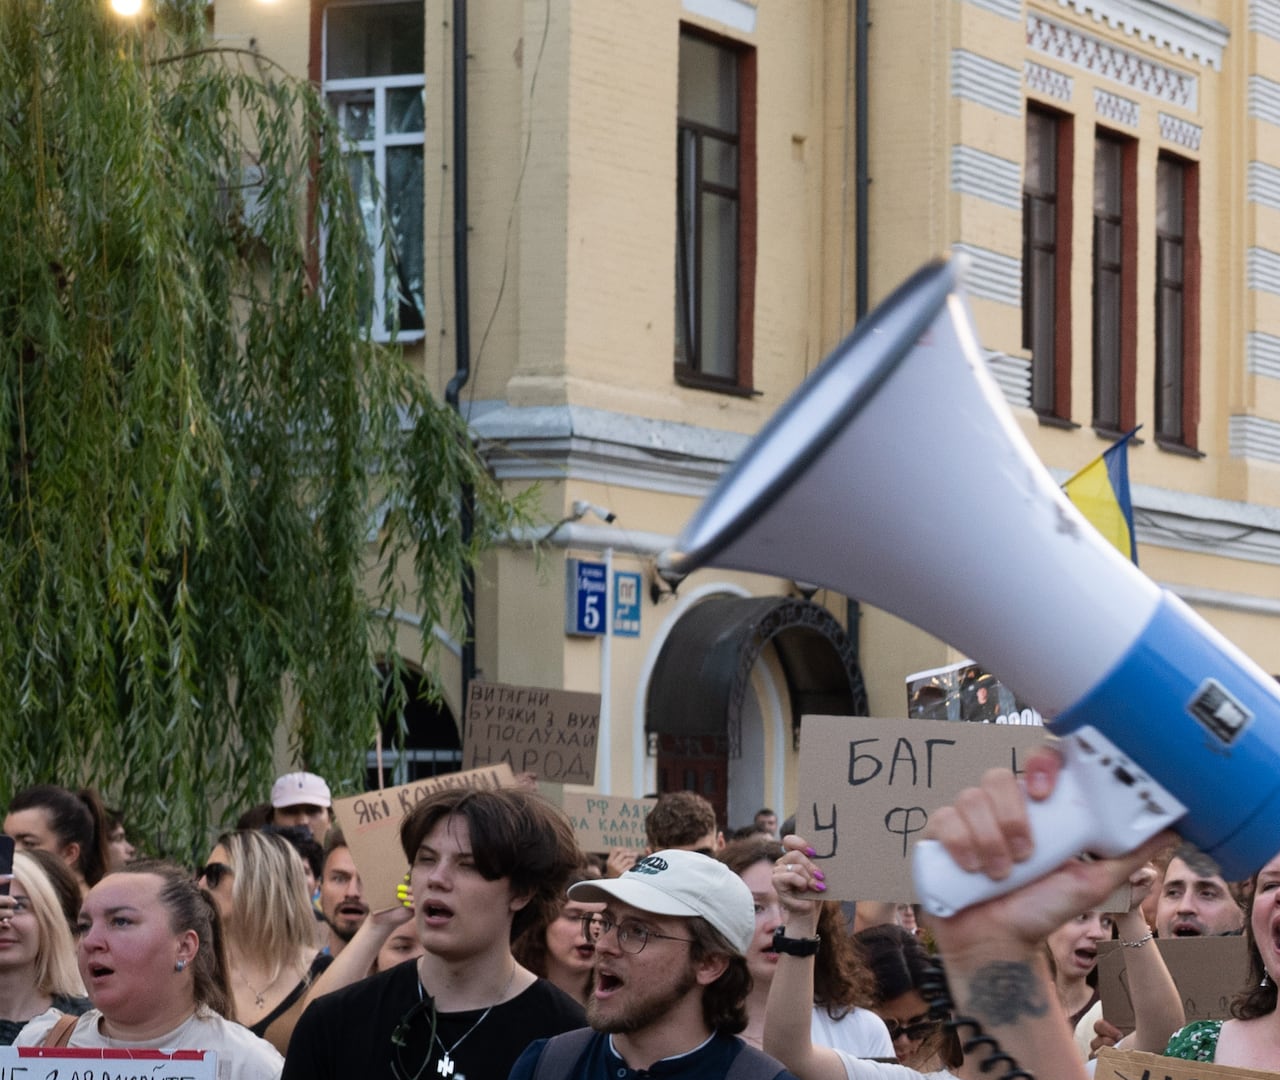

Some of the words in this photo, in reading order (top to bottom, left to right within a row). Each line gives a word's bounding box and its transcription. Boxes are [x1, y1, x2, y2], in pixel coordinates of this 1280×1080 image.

[584, 595, 600, 629] 5
[471, 686, 549, 706] ВИТЯГНИ
[469, 704, 536, 723] БУРЯКИ
[568, 712, 598, 728] ВУХ
[487, 724, 596, 748] ПОСЛУХАЙ
[848, 737, 956, 788] БАГ
